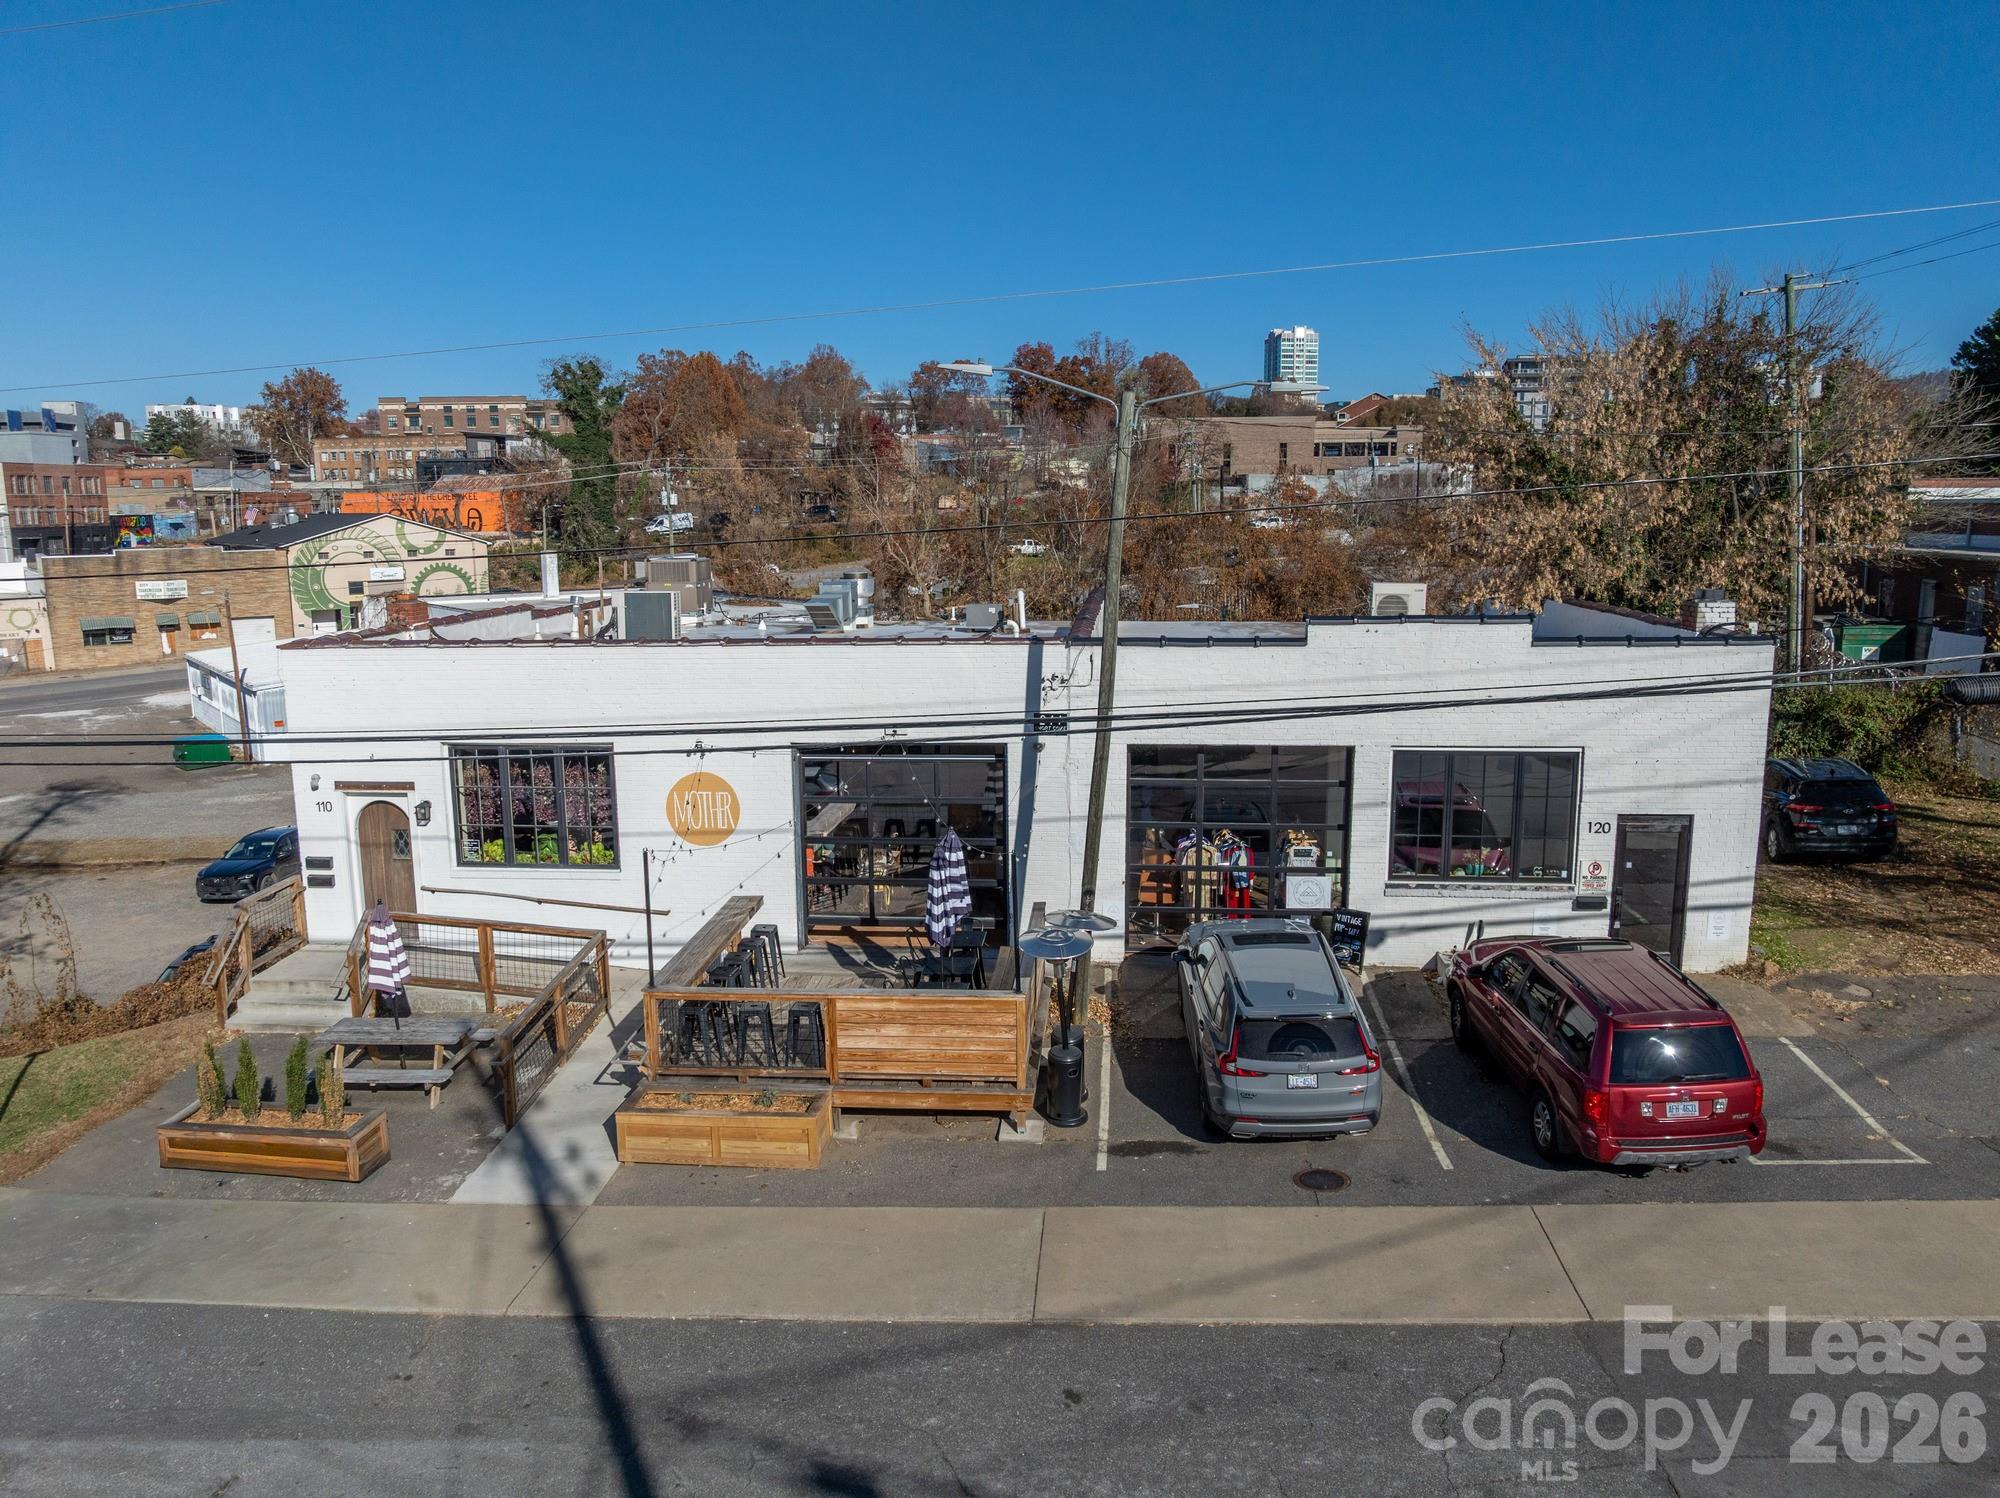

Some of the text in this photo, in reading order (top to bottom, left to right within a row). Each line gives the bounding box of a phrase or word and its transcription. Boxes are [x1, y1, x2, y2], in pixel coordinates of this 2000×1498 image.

[315, 801, 333, 813] 110
[673, 790, 736, 830] MOTHER
[1587, 822, 1612, 834] 120
[1336, 914, 1363, 926] VINTAGE
